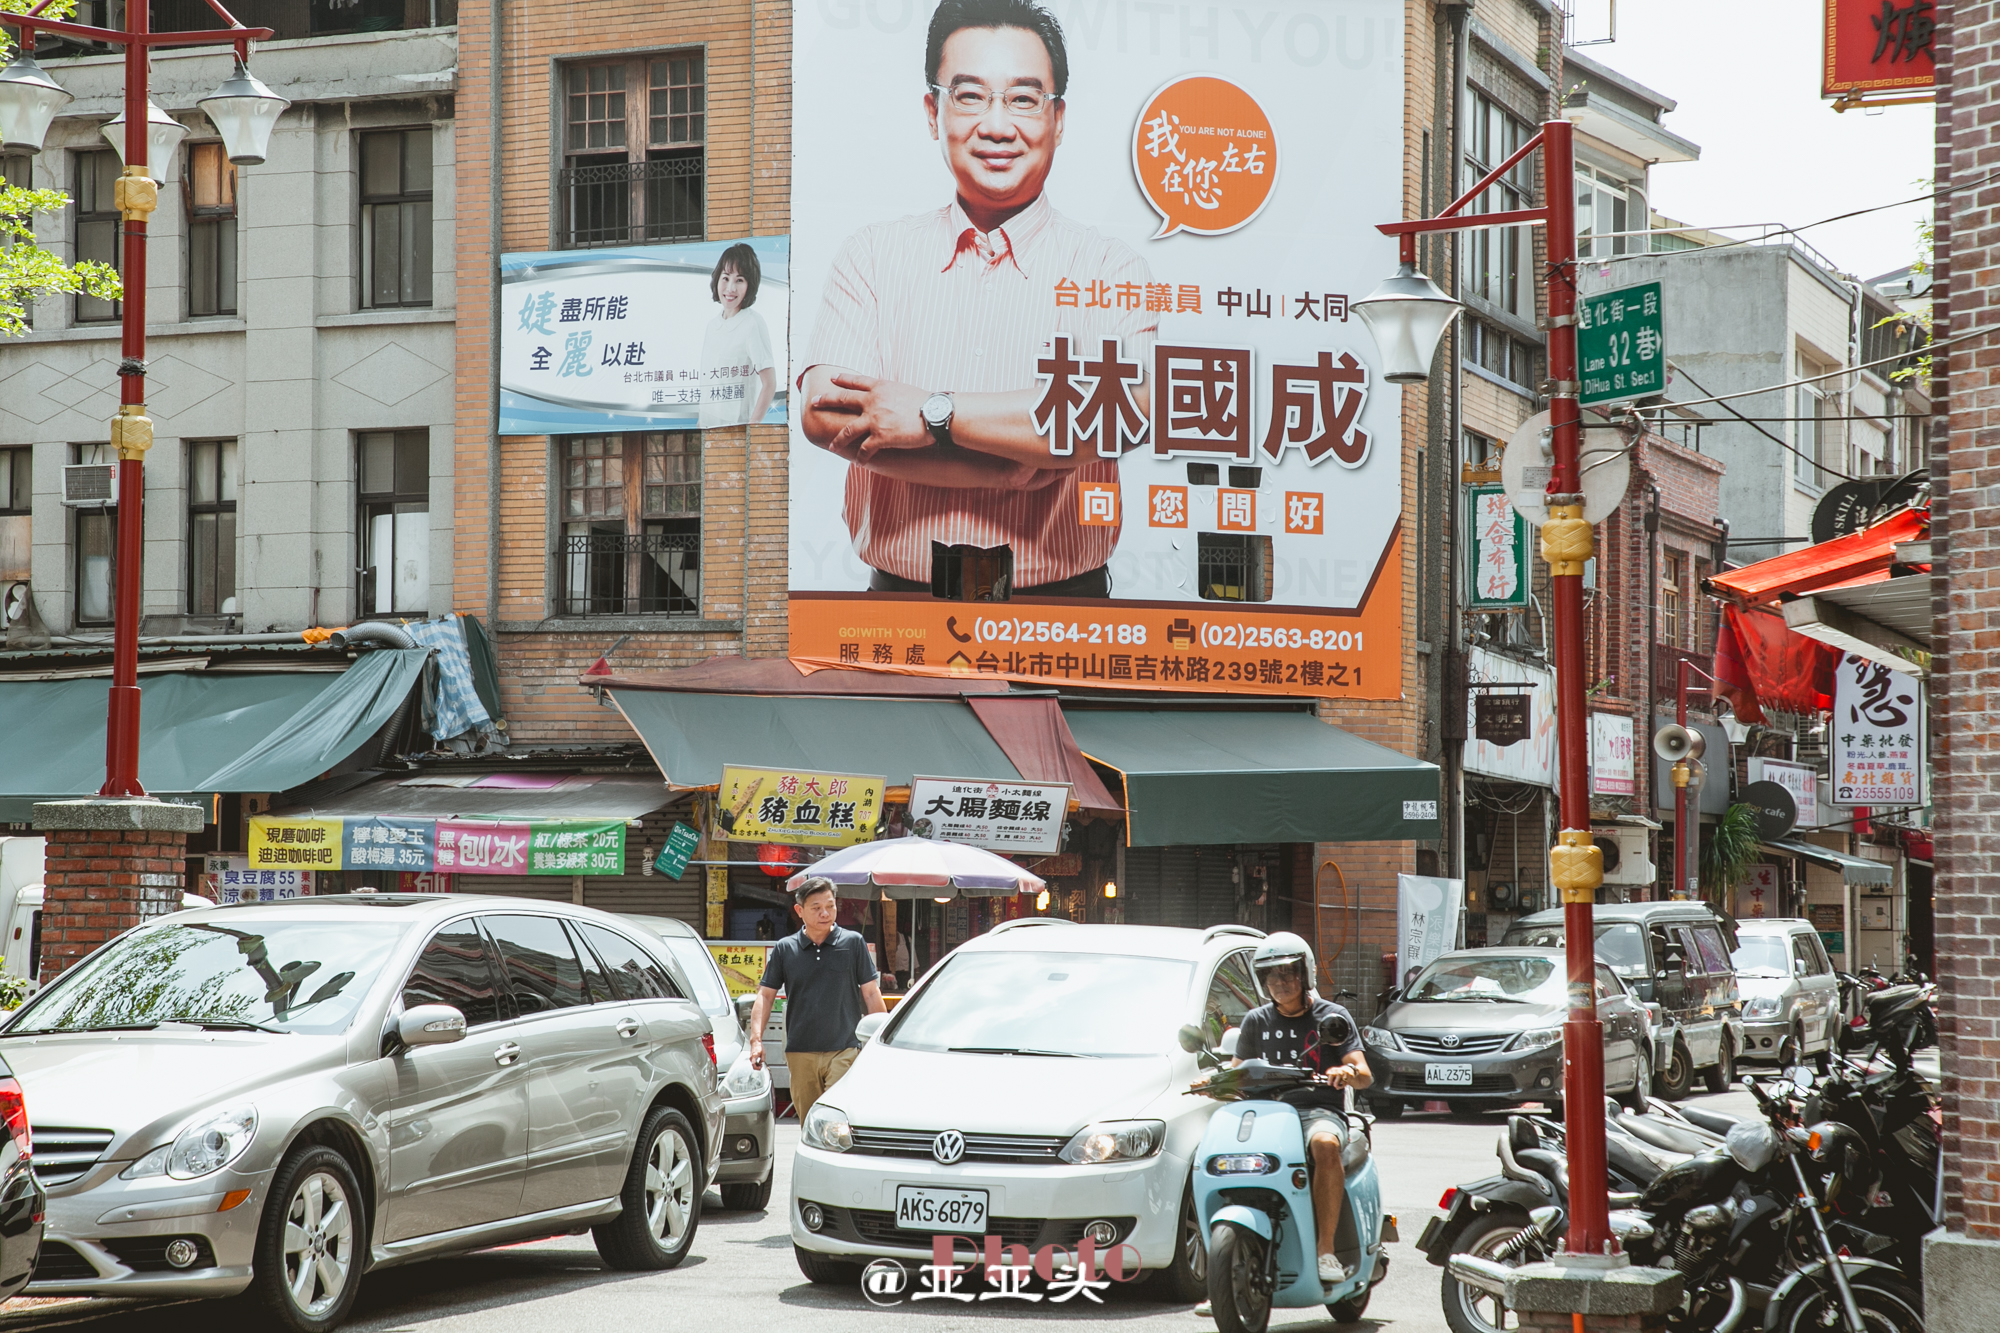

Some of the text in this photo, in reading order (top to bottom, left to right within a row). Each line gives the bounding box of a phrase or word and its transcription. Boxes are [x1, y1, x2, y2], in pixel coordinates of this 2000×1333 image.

[1179, 125, 1267, 139] YOU ARE NOT ALONE!
[1053, 277, 1203, 315] 台北市議員
[1584, 357, 1606, 373] Lane
[623, 370, 674, 384] 台北市議員
[1584, 379, 1611, 395] DiHua
[1614, 373, 1627, 390] St.
[651, 384, 745, 404] 唯一支持 林婕麗
[1031, 333, 1371, 467] 林國成
[973, 617, 1148, 646] (02)2564-2188
[1200, 621, 1365, 652] (02)2563-8201
[839, 643, 926, 667] 服務處
[975, 650, 1363, 688] 台北市中山區吉林路239號2樓之1
[1840, 733, 1914, 748] 中藥批發
[777, 775, 848, 798] 豬大郎
[1855, 787, 1914, 800] 25555109
[757, 796, 857, 830] 豬血糕
[924, 795, 1052, 821] 大腸麵線
[266, 827, 326, 844] 現磨咖啡
[352, 826, 425, 845] 檸檬愛玉
[534, 831, 619, 849] 紅/綠茶 20元
[258, 847, 333, 864] 迪迪咖啡吧
[351, 847, 426, 866] 酸梅湯 35元
[457, 833, 526, 868] 刨冰
[209, 860, 230, 871] 永樂
[591, 852, 618, 869] 30元
[717, 954, 755, 966] 豬血糕
